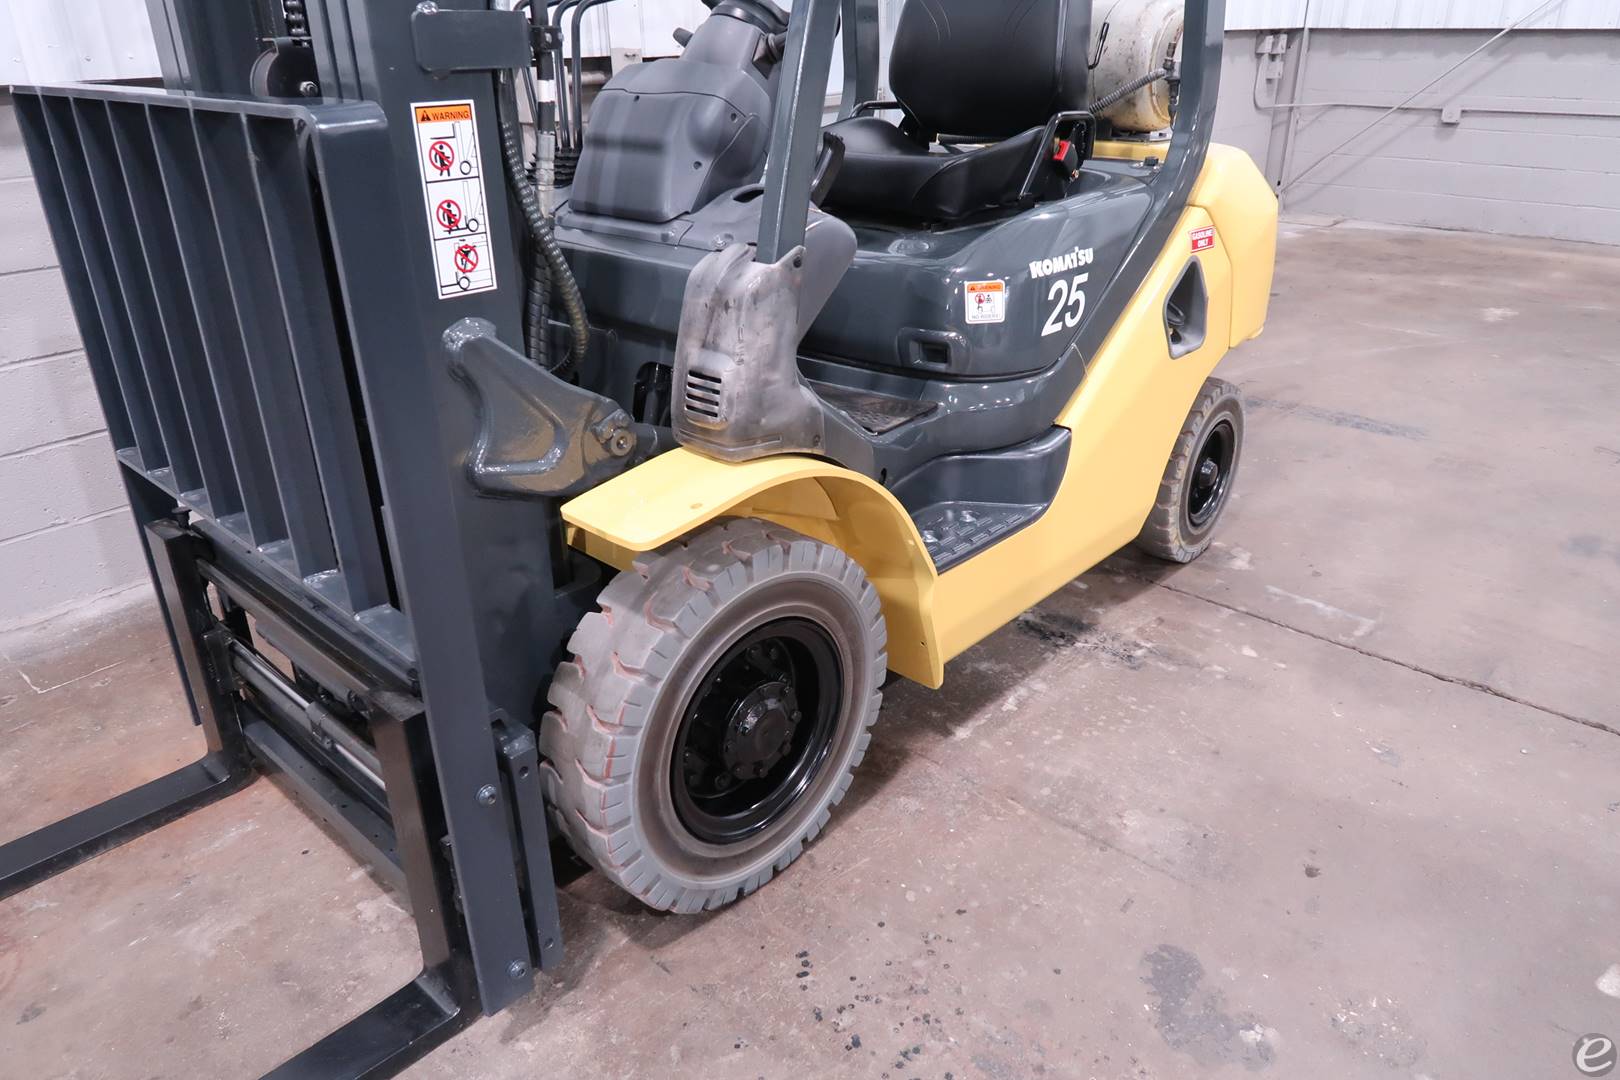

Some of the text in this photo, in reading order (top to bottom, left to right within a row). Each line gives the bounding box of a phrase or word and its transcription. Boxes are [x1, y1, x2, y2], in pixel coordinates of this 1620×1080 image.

[431, 110, 470, 121] WARNING
[1197, 239, 1209, 247] ONLY
[1029, 246, 1094, 279] KOMATSU
[1041, 272, 1089, 337] 25
